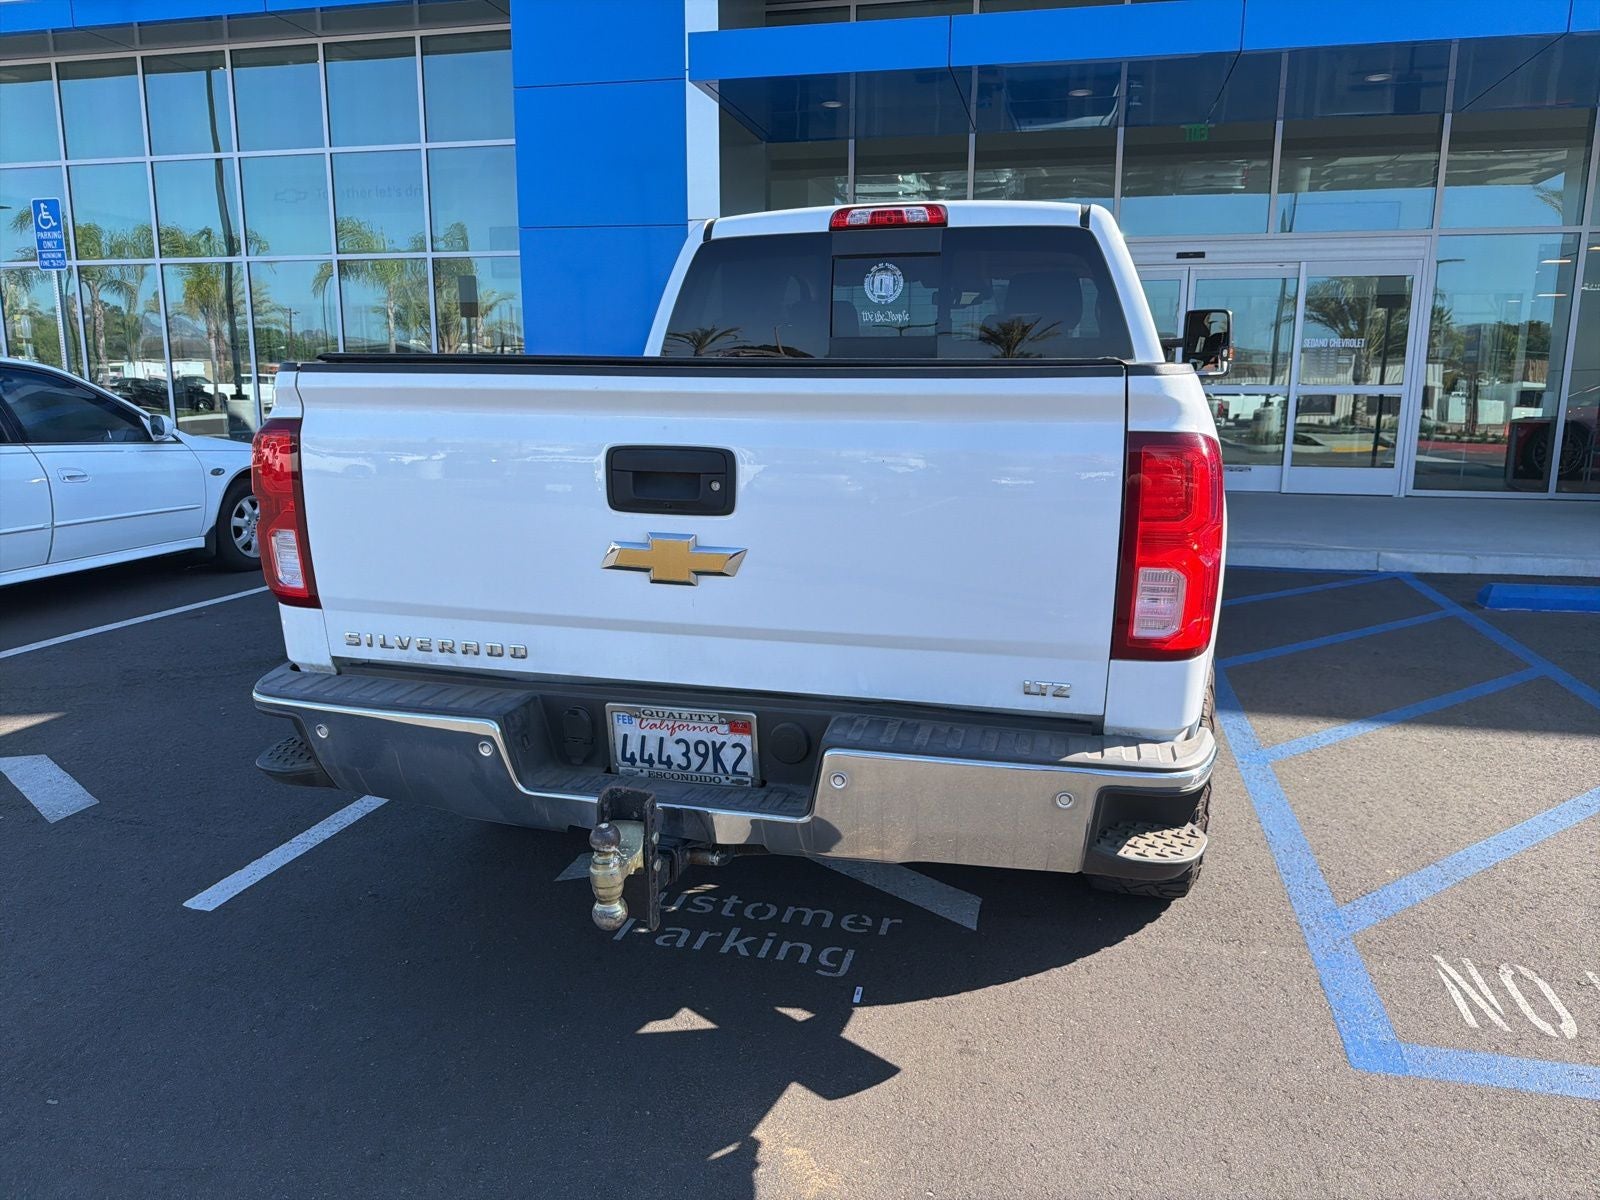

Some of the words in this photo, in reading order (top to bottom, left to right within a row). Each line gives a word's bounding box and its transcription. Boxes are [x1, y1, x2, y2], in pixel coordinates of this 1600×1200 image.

[37, 231, 62, 239] PARKING
[42, 240, 58, 249] ONLY
[886, 310, 910, 322] People
[1330, 338, 1365, 347] CHEVROLET
[344, 631, 528, 659] SILVERADO
[1023, 679, 1072, 699] LTZ
[616, 713, 634, 726] FEB
[642, 709, 717, 722] QUALITY
[638, 718, 725, 736] California
[621, 733, 749, 776] 44439K2
[647, 771, 722, 784] ESCONDIDO
[658, 891, 903, 936] ustomer
[1431, 953, 1579, 1041] NO
